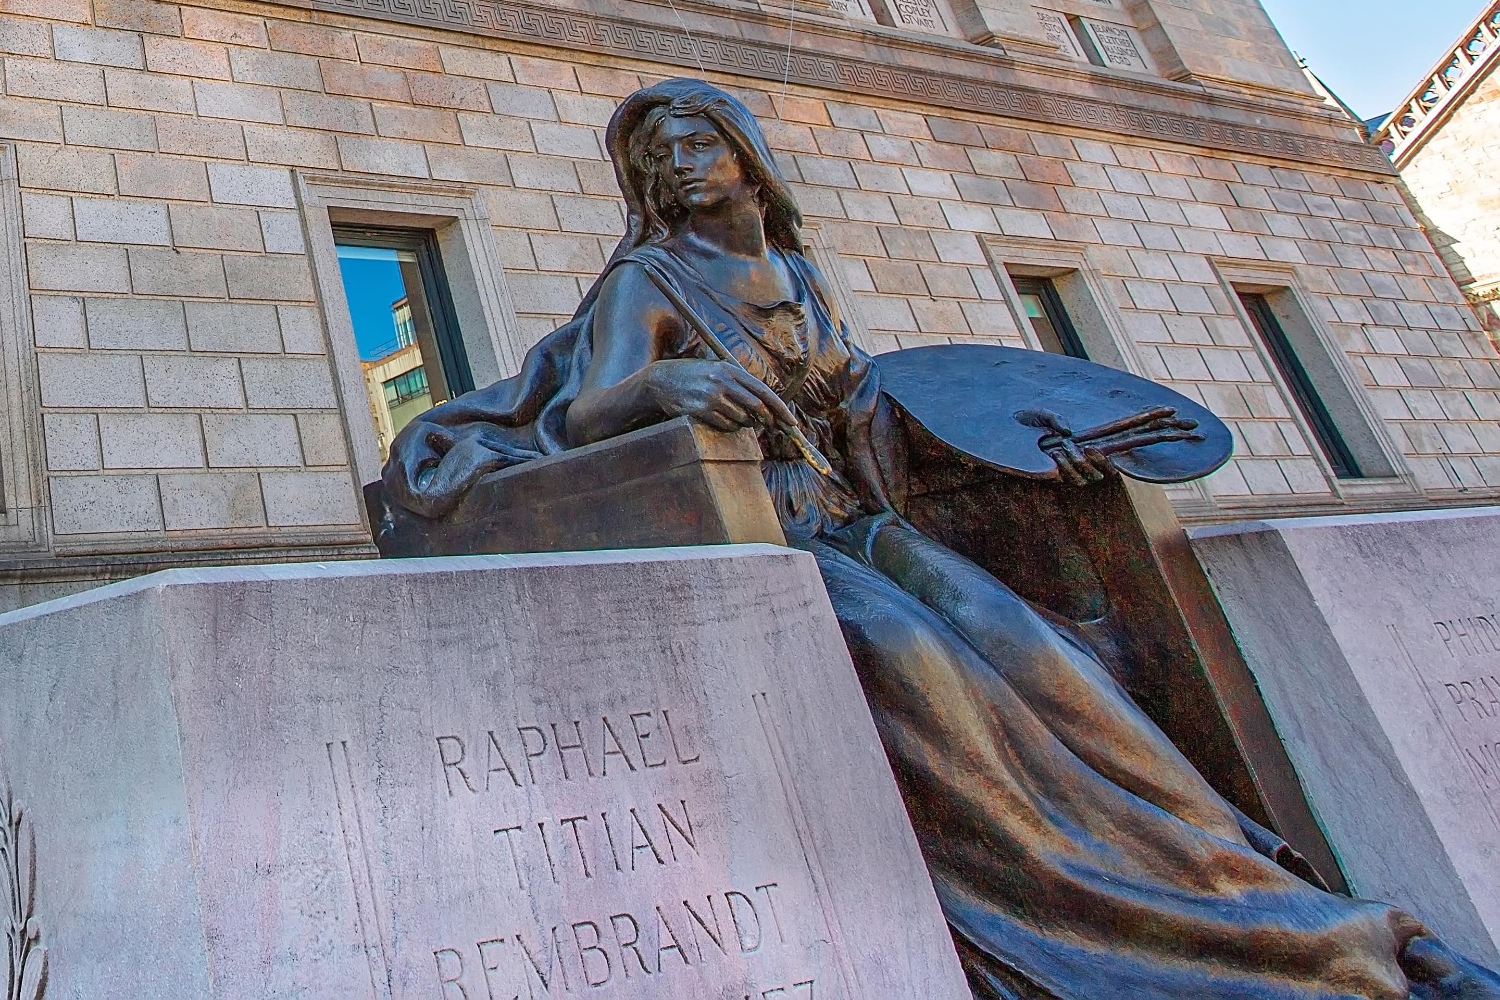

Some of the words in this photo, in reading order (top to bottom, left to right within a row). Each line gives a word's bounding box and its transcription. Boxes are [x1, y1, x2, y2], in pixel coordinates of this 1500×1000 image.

[899, 4, 931, 18] COPLEY
[904, 15, 936, 28] STVART
[435, 709, 701, 798] RAPHAEL
[493, 799, 700, 891] TITIAN
[432, 882, 787, 1000] REMBRANDT
